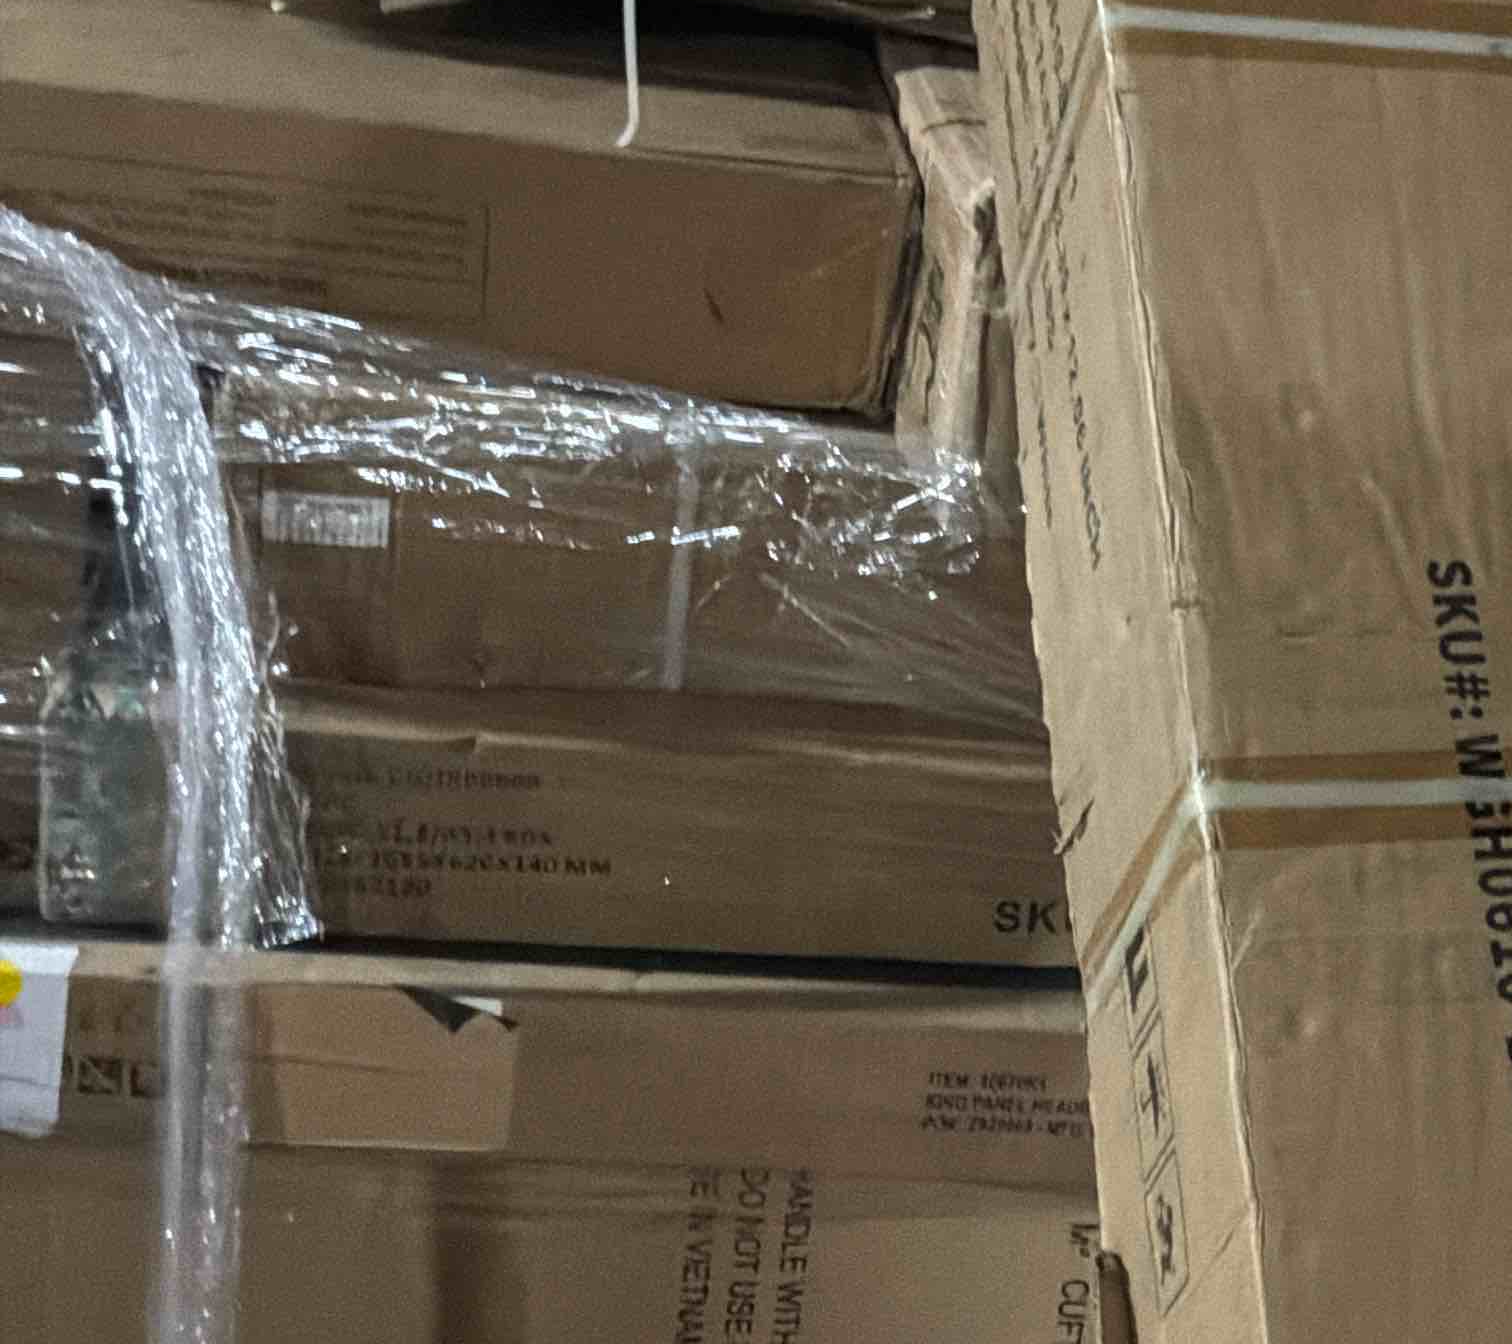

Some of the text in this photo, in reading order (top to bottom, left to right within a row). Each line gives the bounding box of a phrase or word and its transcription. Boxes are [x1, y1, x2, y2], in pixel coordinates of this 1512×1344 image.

[1426, 558, 1492, 721] SKU#:
[994, 899, 1071, 934] SK
[723, 1279, 760, 1337] USE
